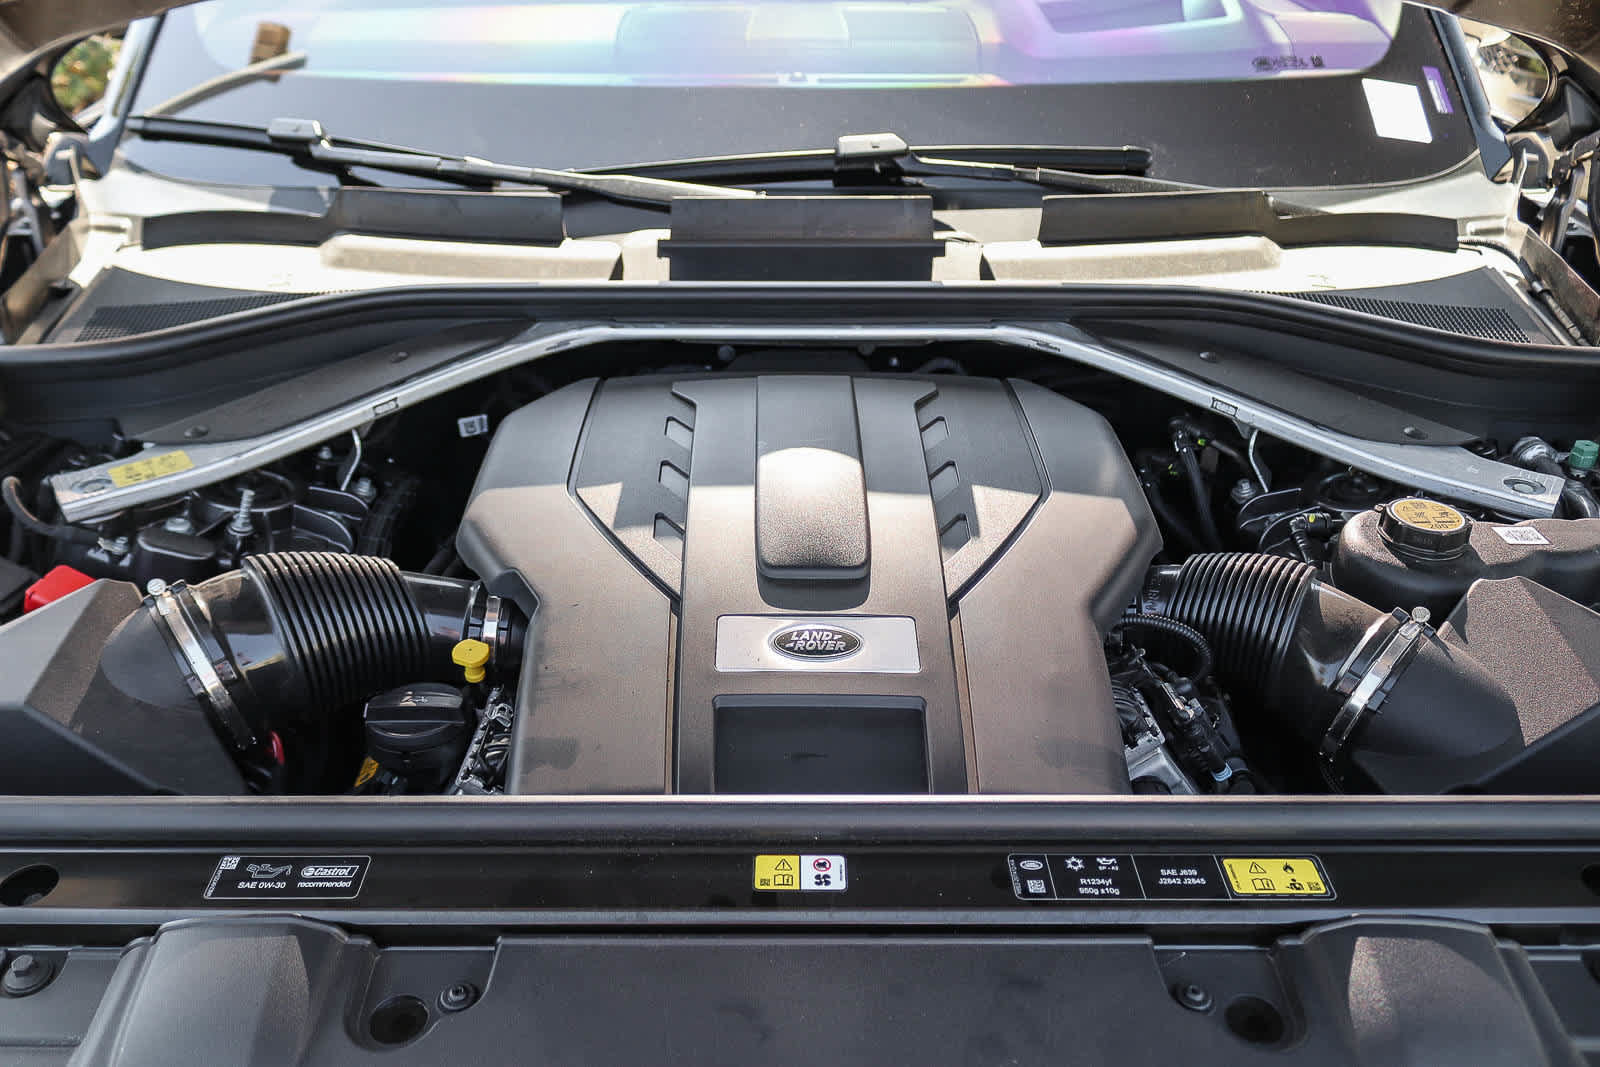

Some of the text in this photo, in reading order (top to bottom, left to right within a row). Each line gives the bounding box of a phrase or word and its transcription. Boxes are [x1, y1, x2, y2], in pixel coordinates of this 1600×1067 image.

[791, 631, 833, 640] LAND
[793, 641, 846, 651] ROVER
[314, 867, 351, 876] Castrol
[237, 881, 287, 889] SAE 0W-30
[297, 880, 352, 888] recommended
